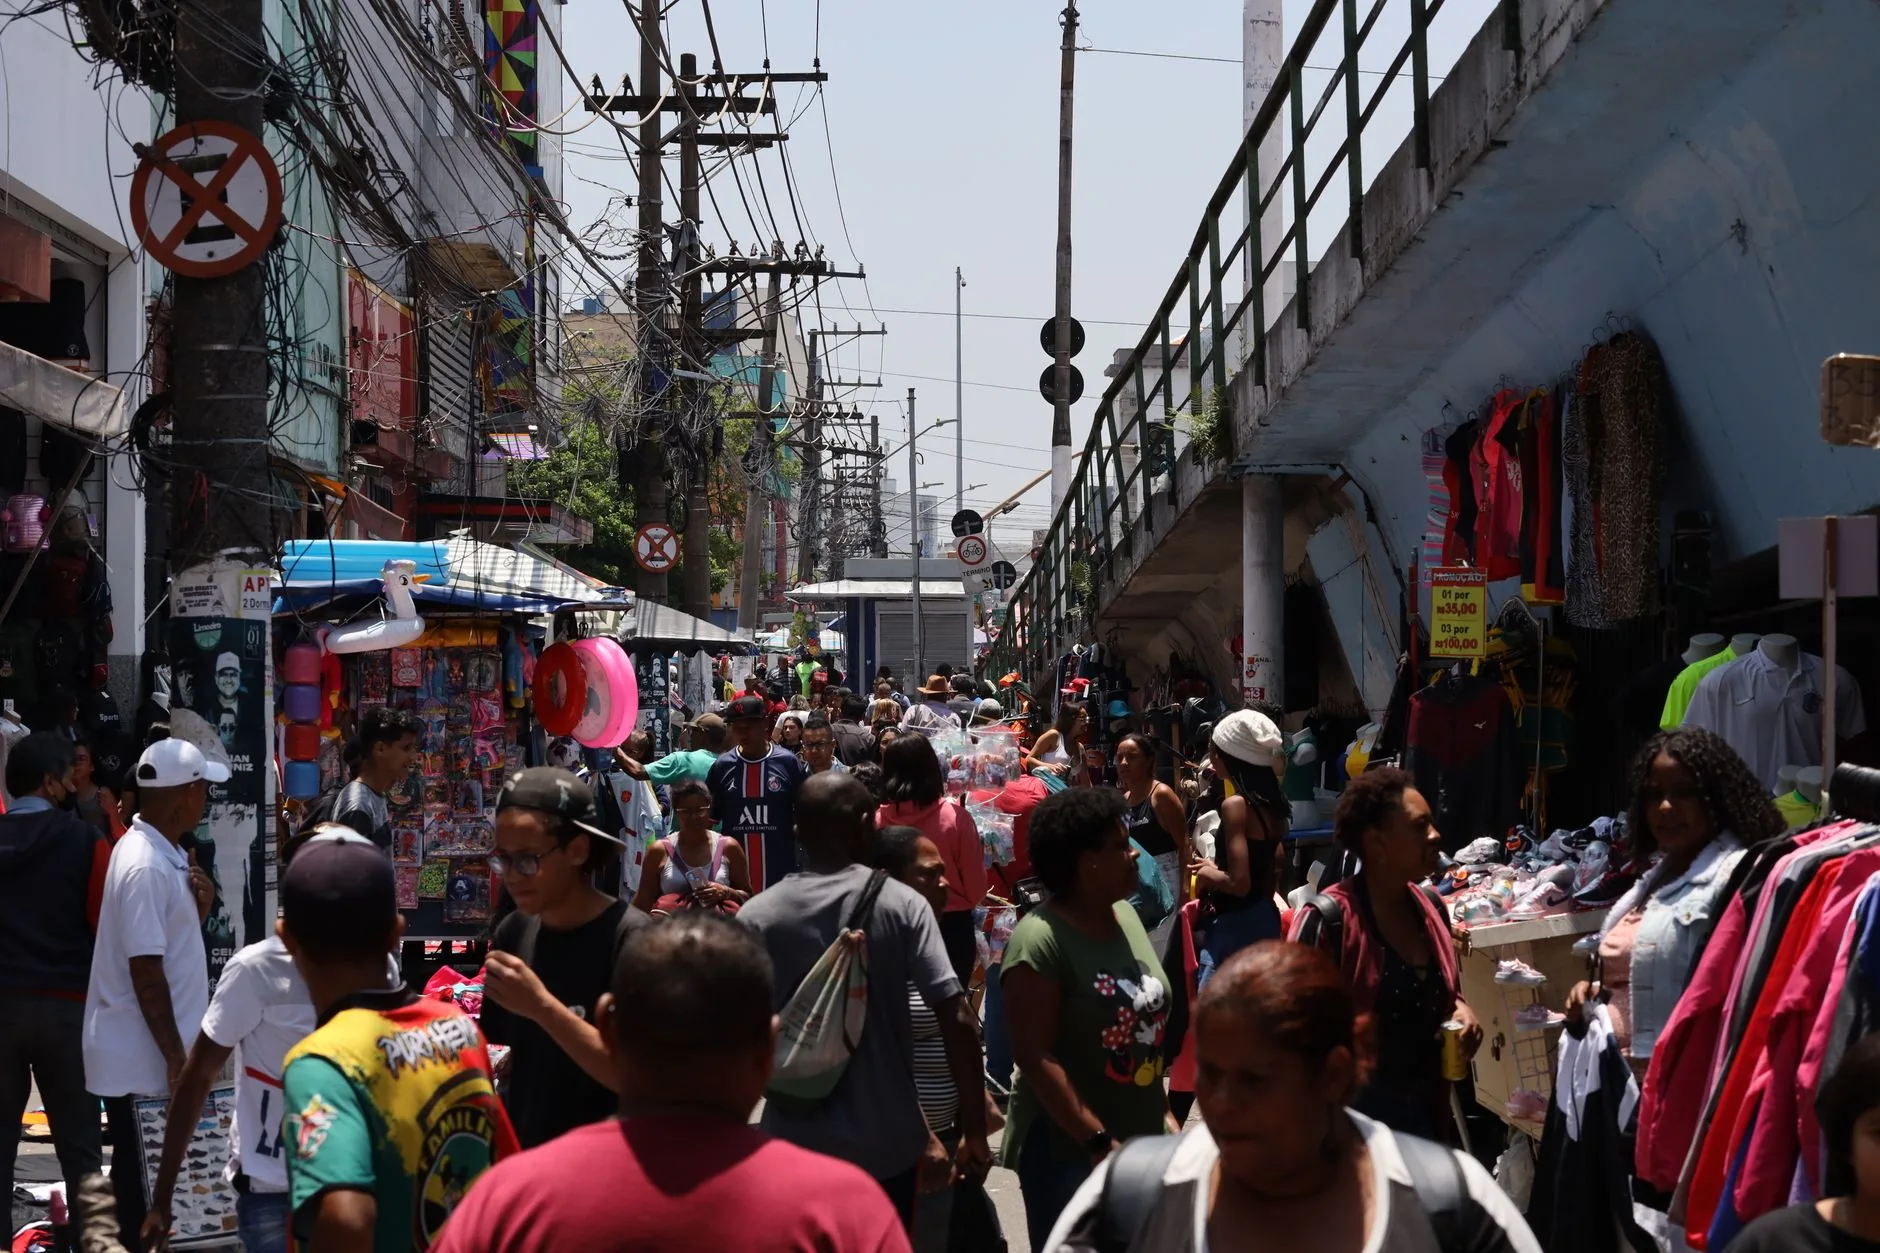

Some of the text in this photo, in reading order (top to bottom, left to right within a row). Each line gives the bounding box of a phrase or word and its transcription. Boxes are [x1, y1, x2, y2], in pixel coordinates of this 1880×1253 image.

[1441, 589, 1470, 601] 01 por
[242, 598, 249, 608] 2
[1441, 623, 1470, 635] 03 por
[247, 630, 260, 645] 01
